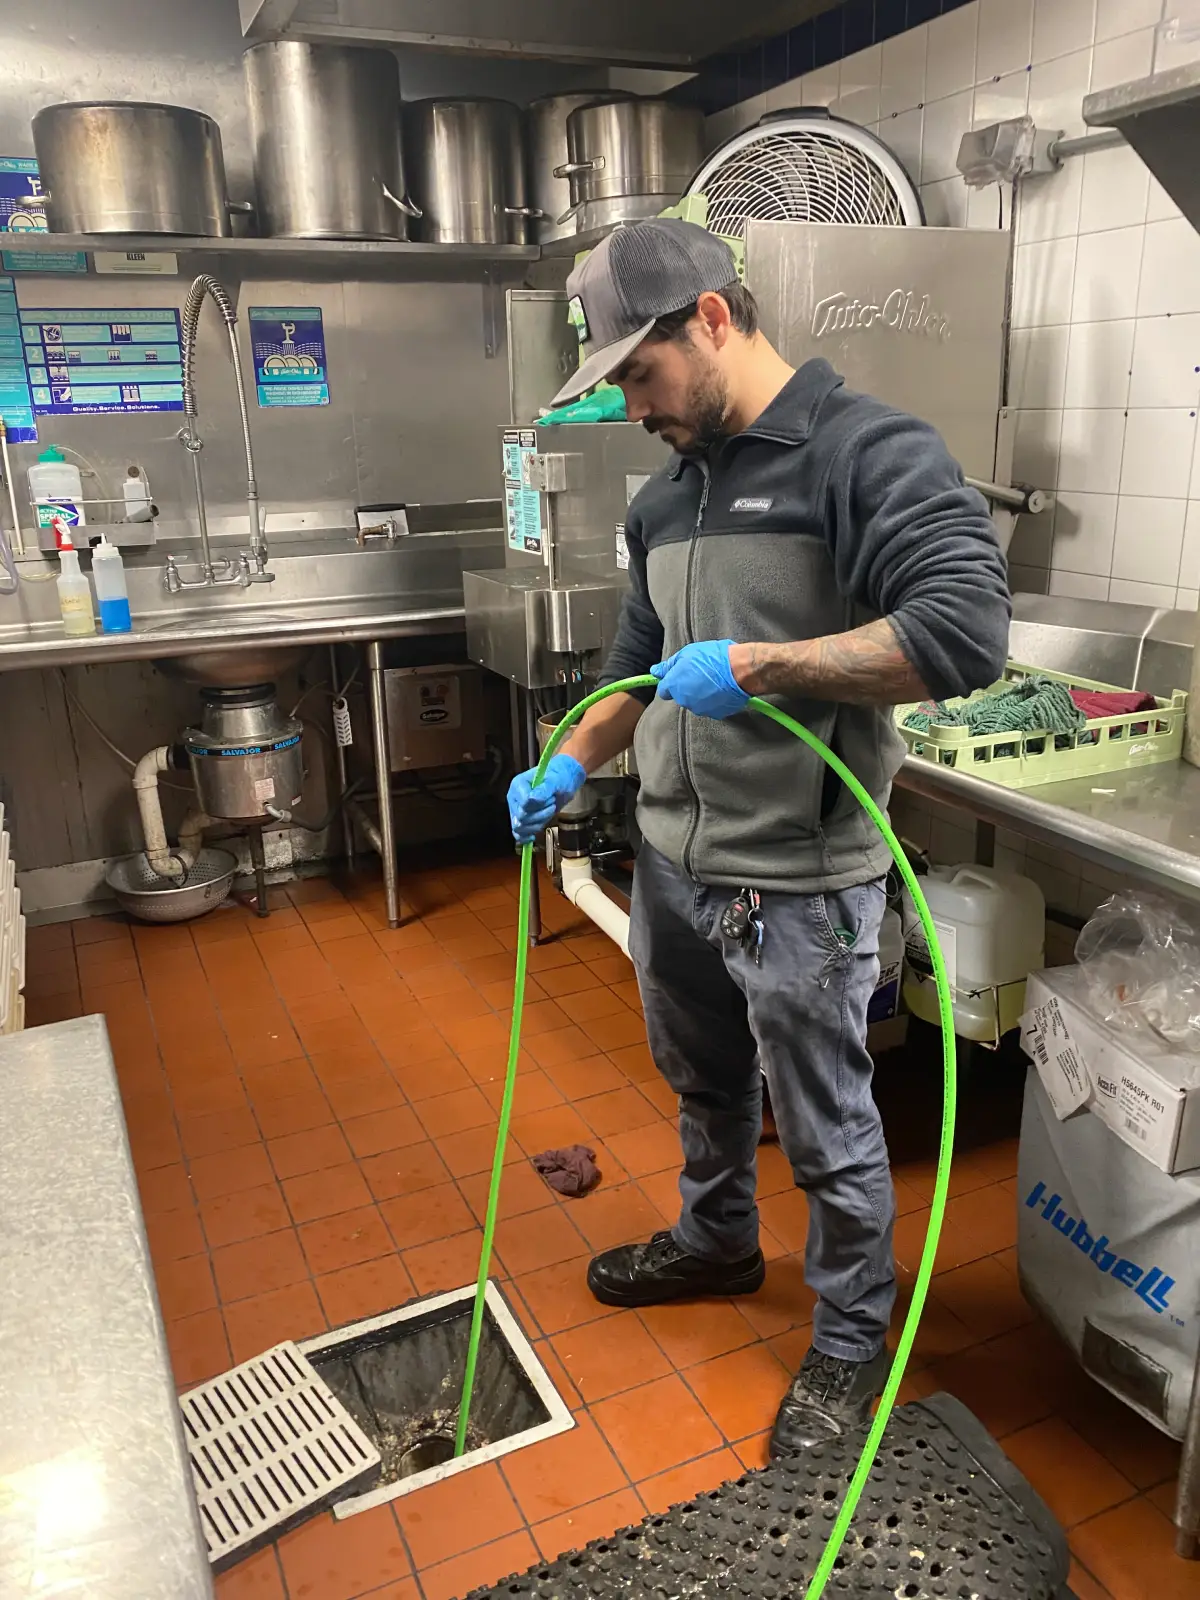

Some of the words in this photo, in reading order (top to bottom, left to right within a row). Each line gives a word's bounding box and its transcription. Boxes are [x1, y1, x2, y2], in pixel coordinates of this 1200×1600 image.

[32, 349, 39, 358] 2
[35, 368, 42, 378] 3
[37, 391, 46, 400] 4
[740, 498, 769, 509] Columbia
[273, 736, 300, 750] SALVAJOR
[221, 747, 261, 756] SALVAJOR
[1026, 1181, 1176, 1314] Hubbell
